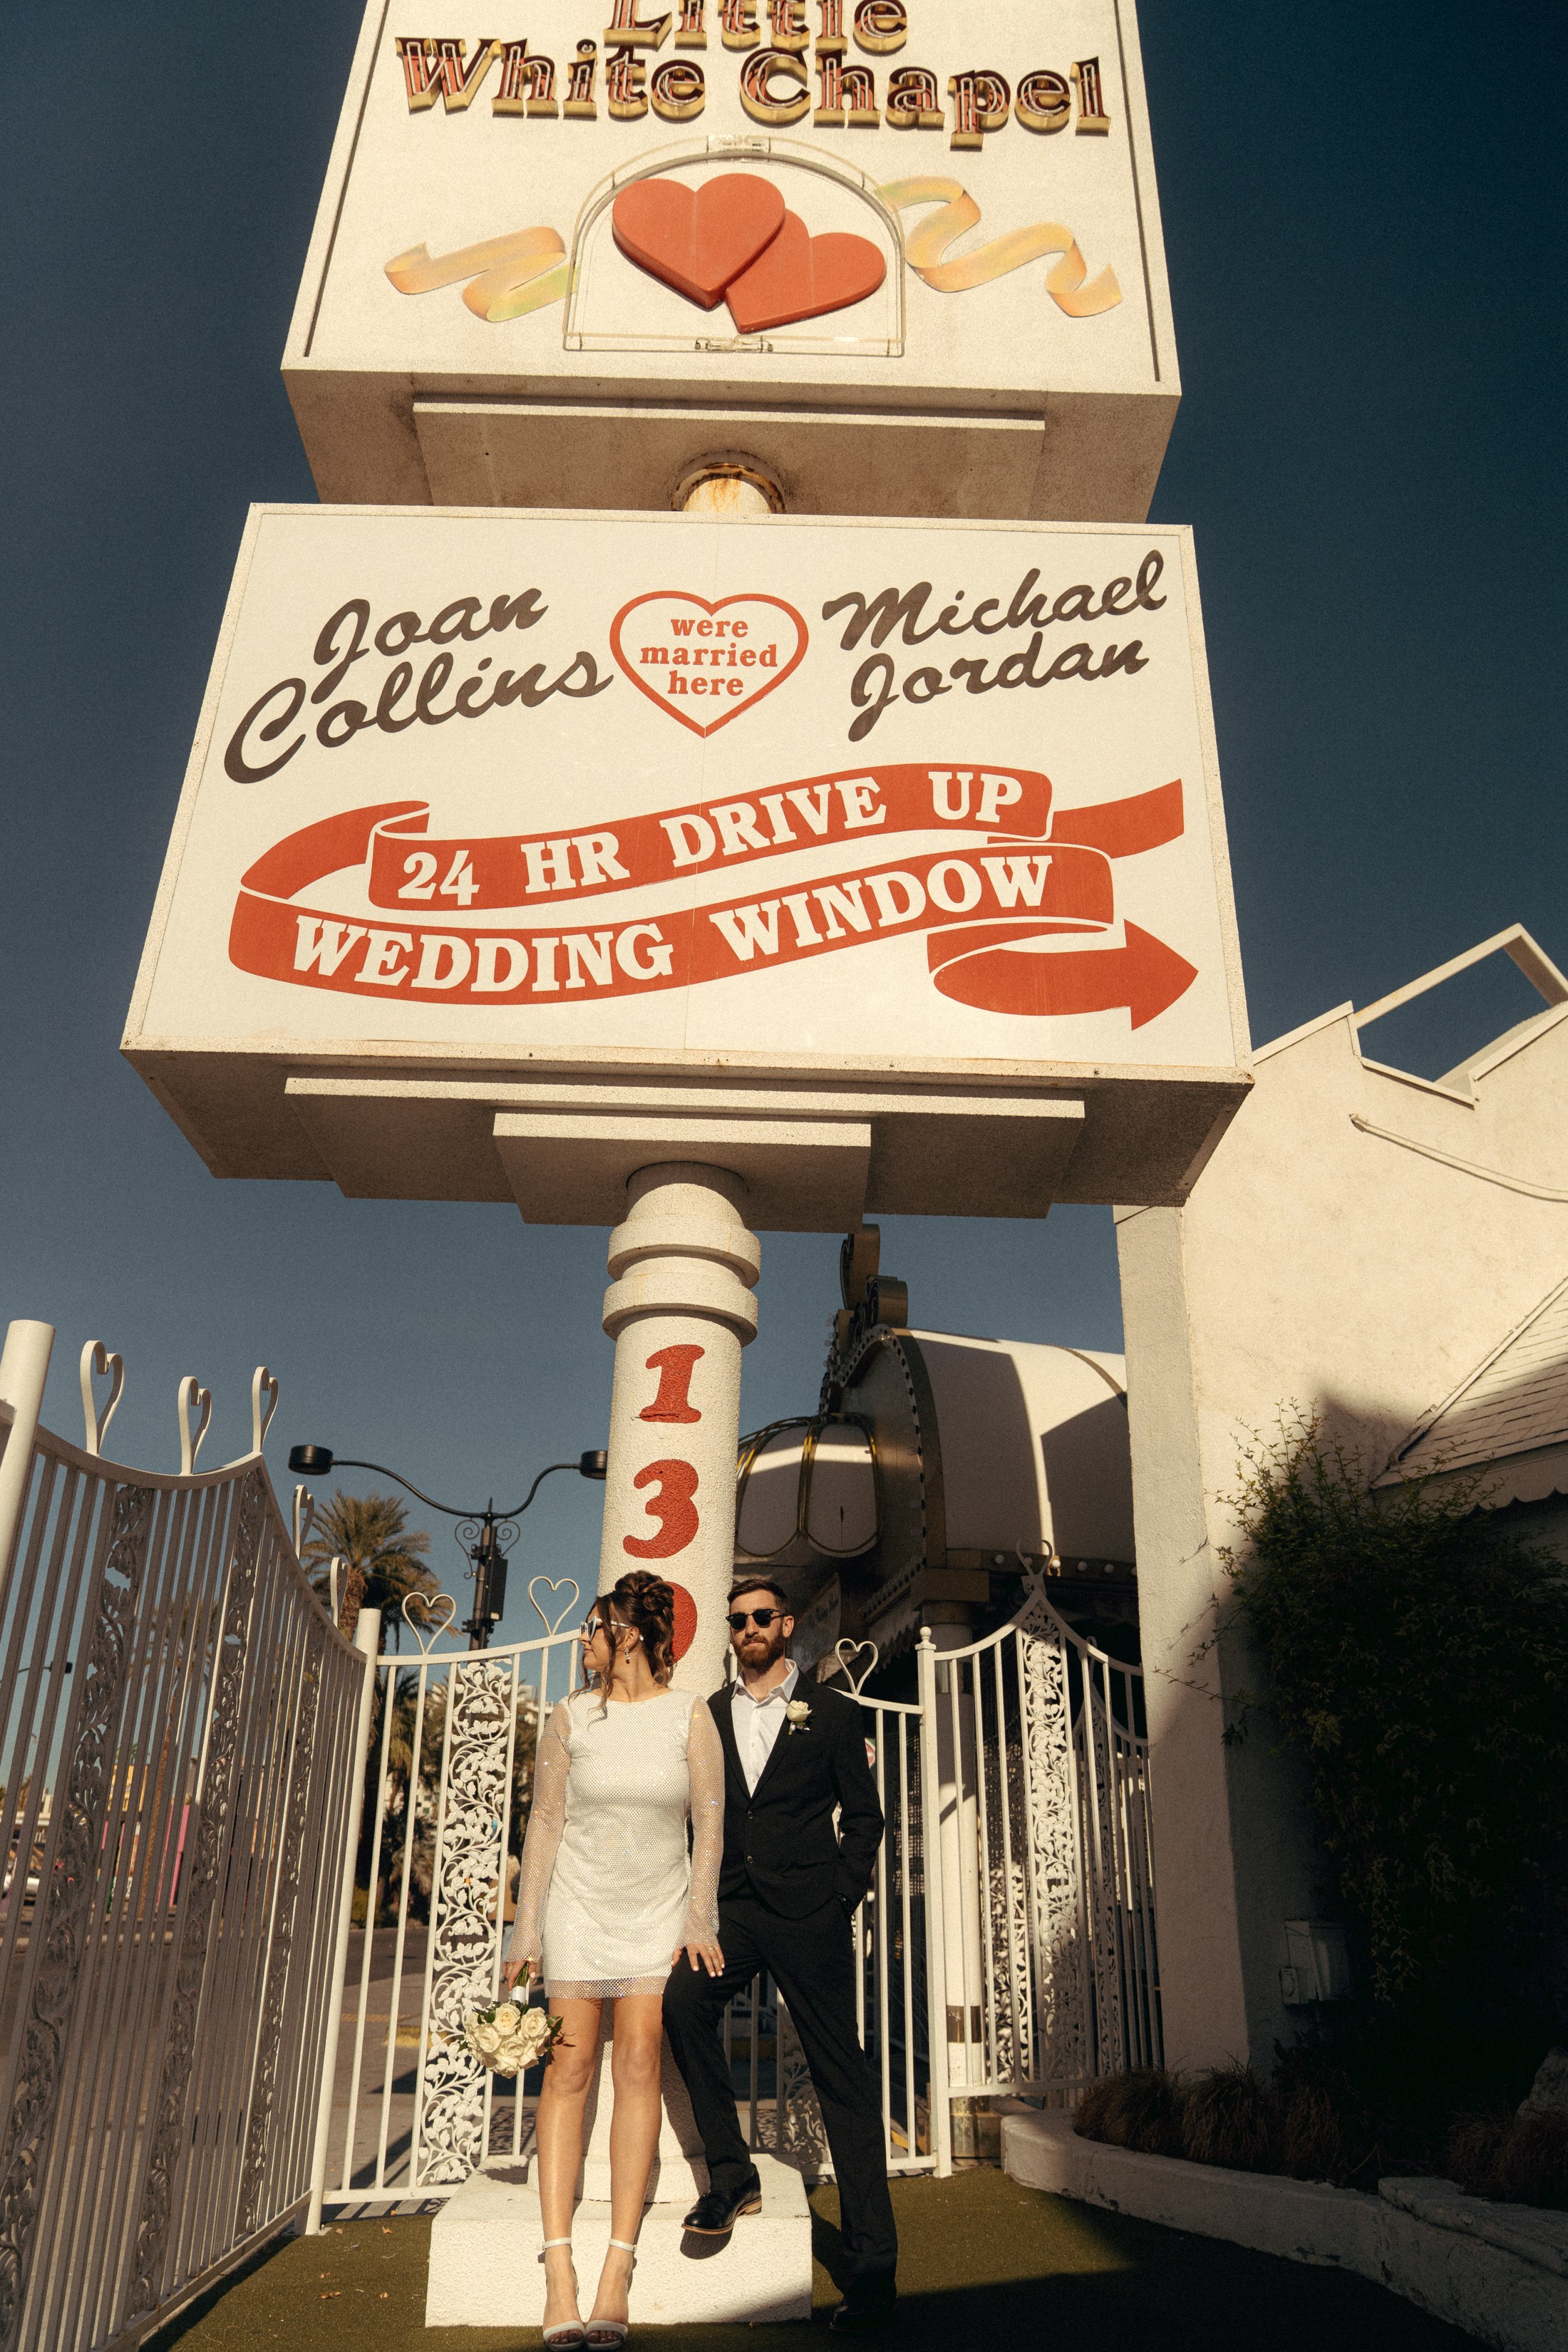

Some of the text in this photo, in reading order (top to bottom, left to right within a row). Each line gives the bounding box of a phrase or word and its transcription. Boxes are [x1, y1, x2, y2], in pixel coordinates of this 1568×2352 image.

[604, 0, 907, 54] Little
[396, 37, 1110, 150] White Chapel
[311, 588, 549, 704] Joan
[639, 643, 778, 668] married
[670, 616, 748, 639] were
[822, 550, 1167, 650] Michael
[224, 651, 614, 784] Collins
[668, 669, 744, 697] here
[848, 630, 1149, 742] Jordan
[398, 770, 1023, 906] 24 HR DRIVE UP
[293, 855, 1053, 993] WEDDING WINDOW
